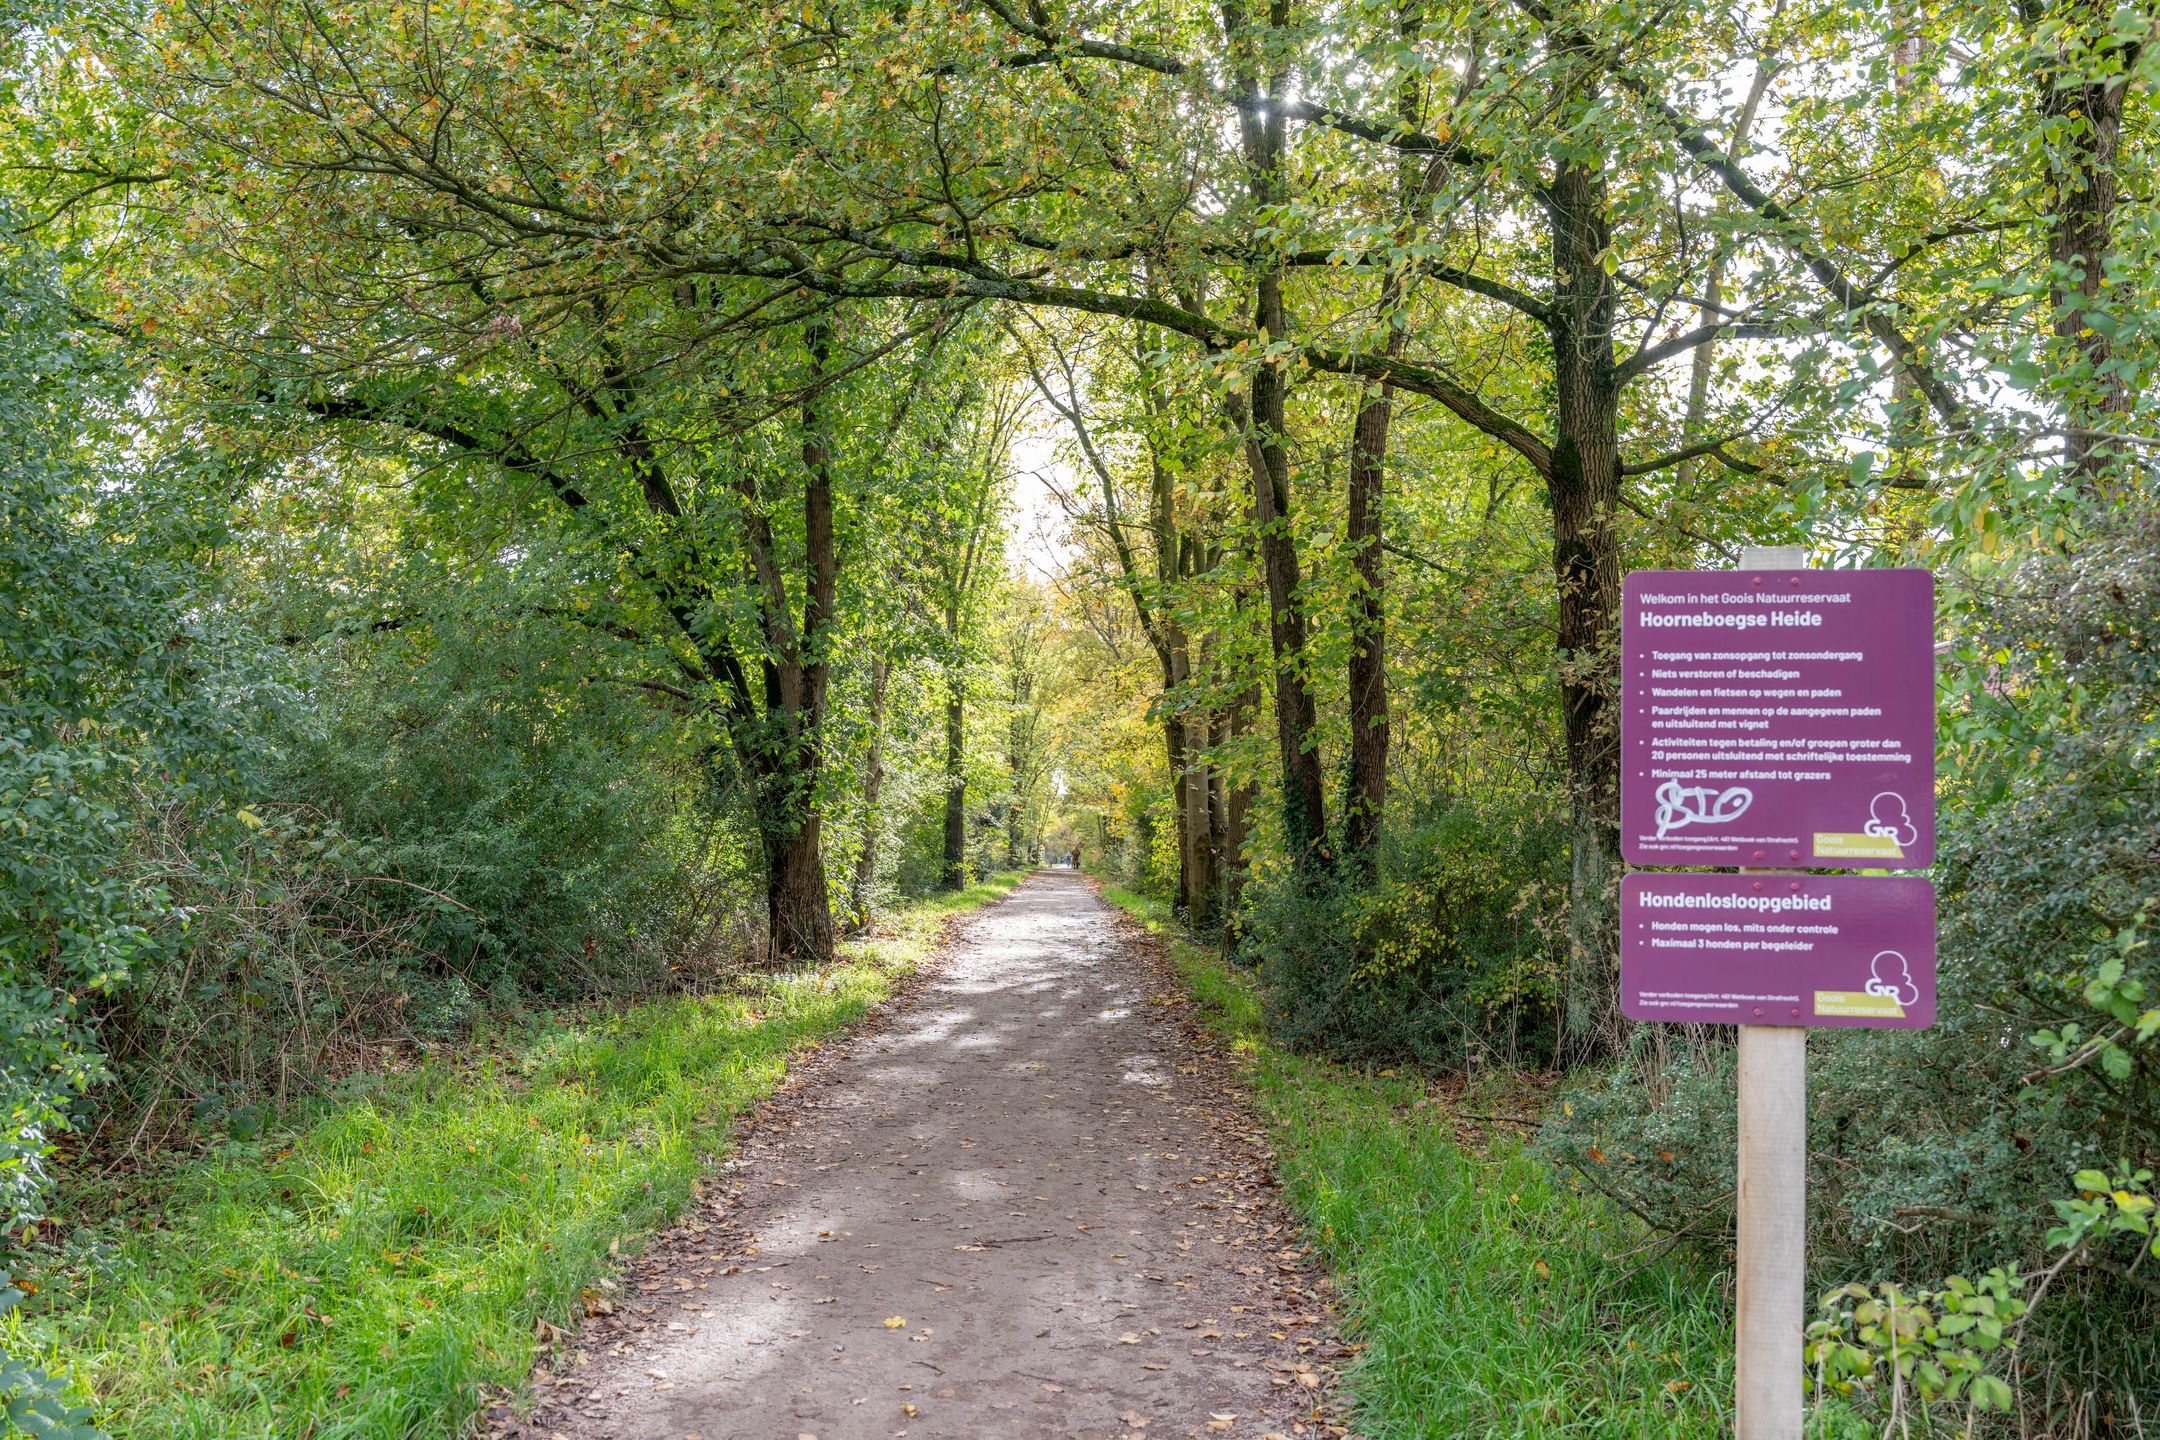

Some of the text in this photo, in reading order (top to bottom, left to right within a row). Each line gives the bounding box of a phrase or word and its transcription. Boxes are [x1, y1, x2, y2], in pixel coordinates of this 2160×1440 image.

[1640, 592, 1851, 604] Welkom in het Goois Natuurreservaat
[1640, 610, 1822, 630] Hoorneboegse Heide
[1652, 650, 1863, 662] Toegang van zonsopgang tot zonsondergang
[1652, 669, 1800, 680] Niets verstoren of beschadigen
[1652, 687, 1841, 699] Wandelen en fietsen op wegen en paden
[1652, 705, 1881, 718] Paardrijden en mennen op de aangegeven paden
[1652, 719, 1769, 730] en uitsluitend met vignet
[1651, 737, 1900, 750] Activiteiten tegen betaling en/of groepen groter dan
[1652, 751, 1911, 764] 20 personen uitsluitend met schriftelijke toestemming
[1652, 769, 1831, 781] Minimaal 25 meter afstand tot grazers
[1864, 820, 1898, 845] GNR
[1640, 891, 1831, 913] Hondenlosloopgebied
[1652, 922, 1838, 934] Honden mogen los, mits onder controle
[1652, 939, 1813, 952] Maximaal 3 honden per begeleider
[1865, 978, 1899, 1004] GNR
